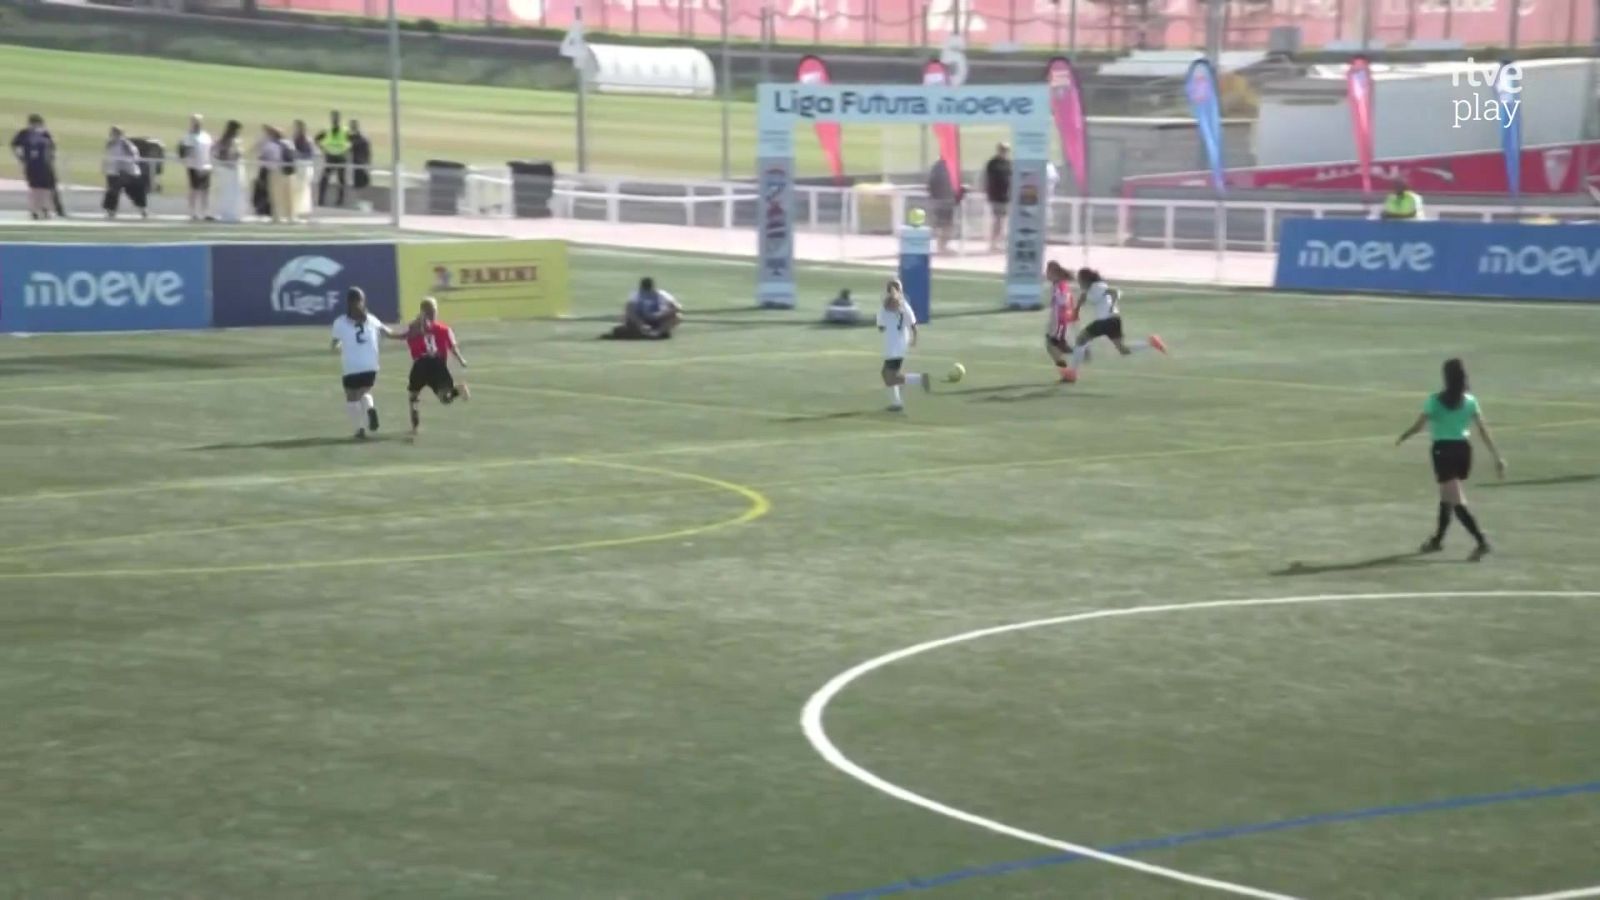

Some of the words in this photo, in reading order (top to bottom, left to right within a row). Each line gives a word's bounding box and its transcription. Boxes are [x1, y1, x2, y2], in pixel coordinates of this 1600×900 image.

[774, 89, 833, 118] Liga
[840, 91, 928, 115] Futura
[936, 95, 1034, 115] moeve
[1297, 239, 1435, 271] moeve
[23, 270, 185, 307] moeve
[459, 265, 538, 285] PANINI
[326, 290, 340, 311] F
